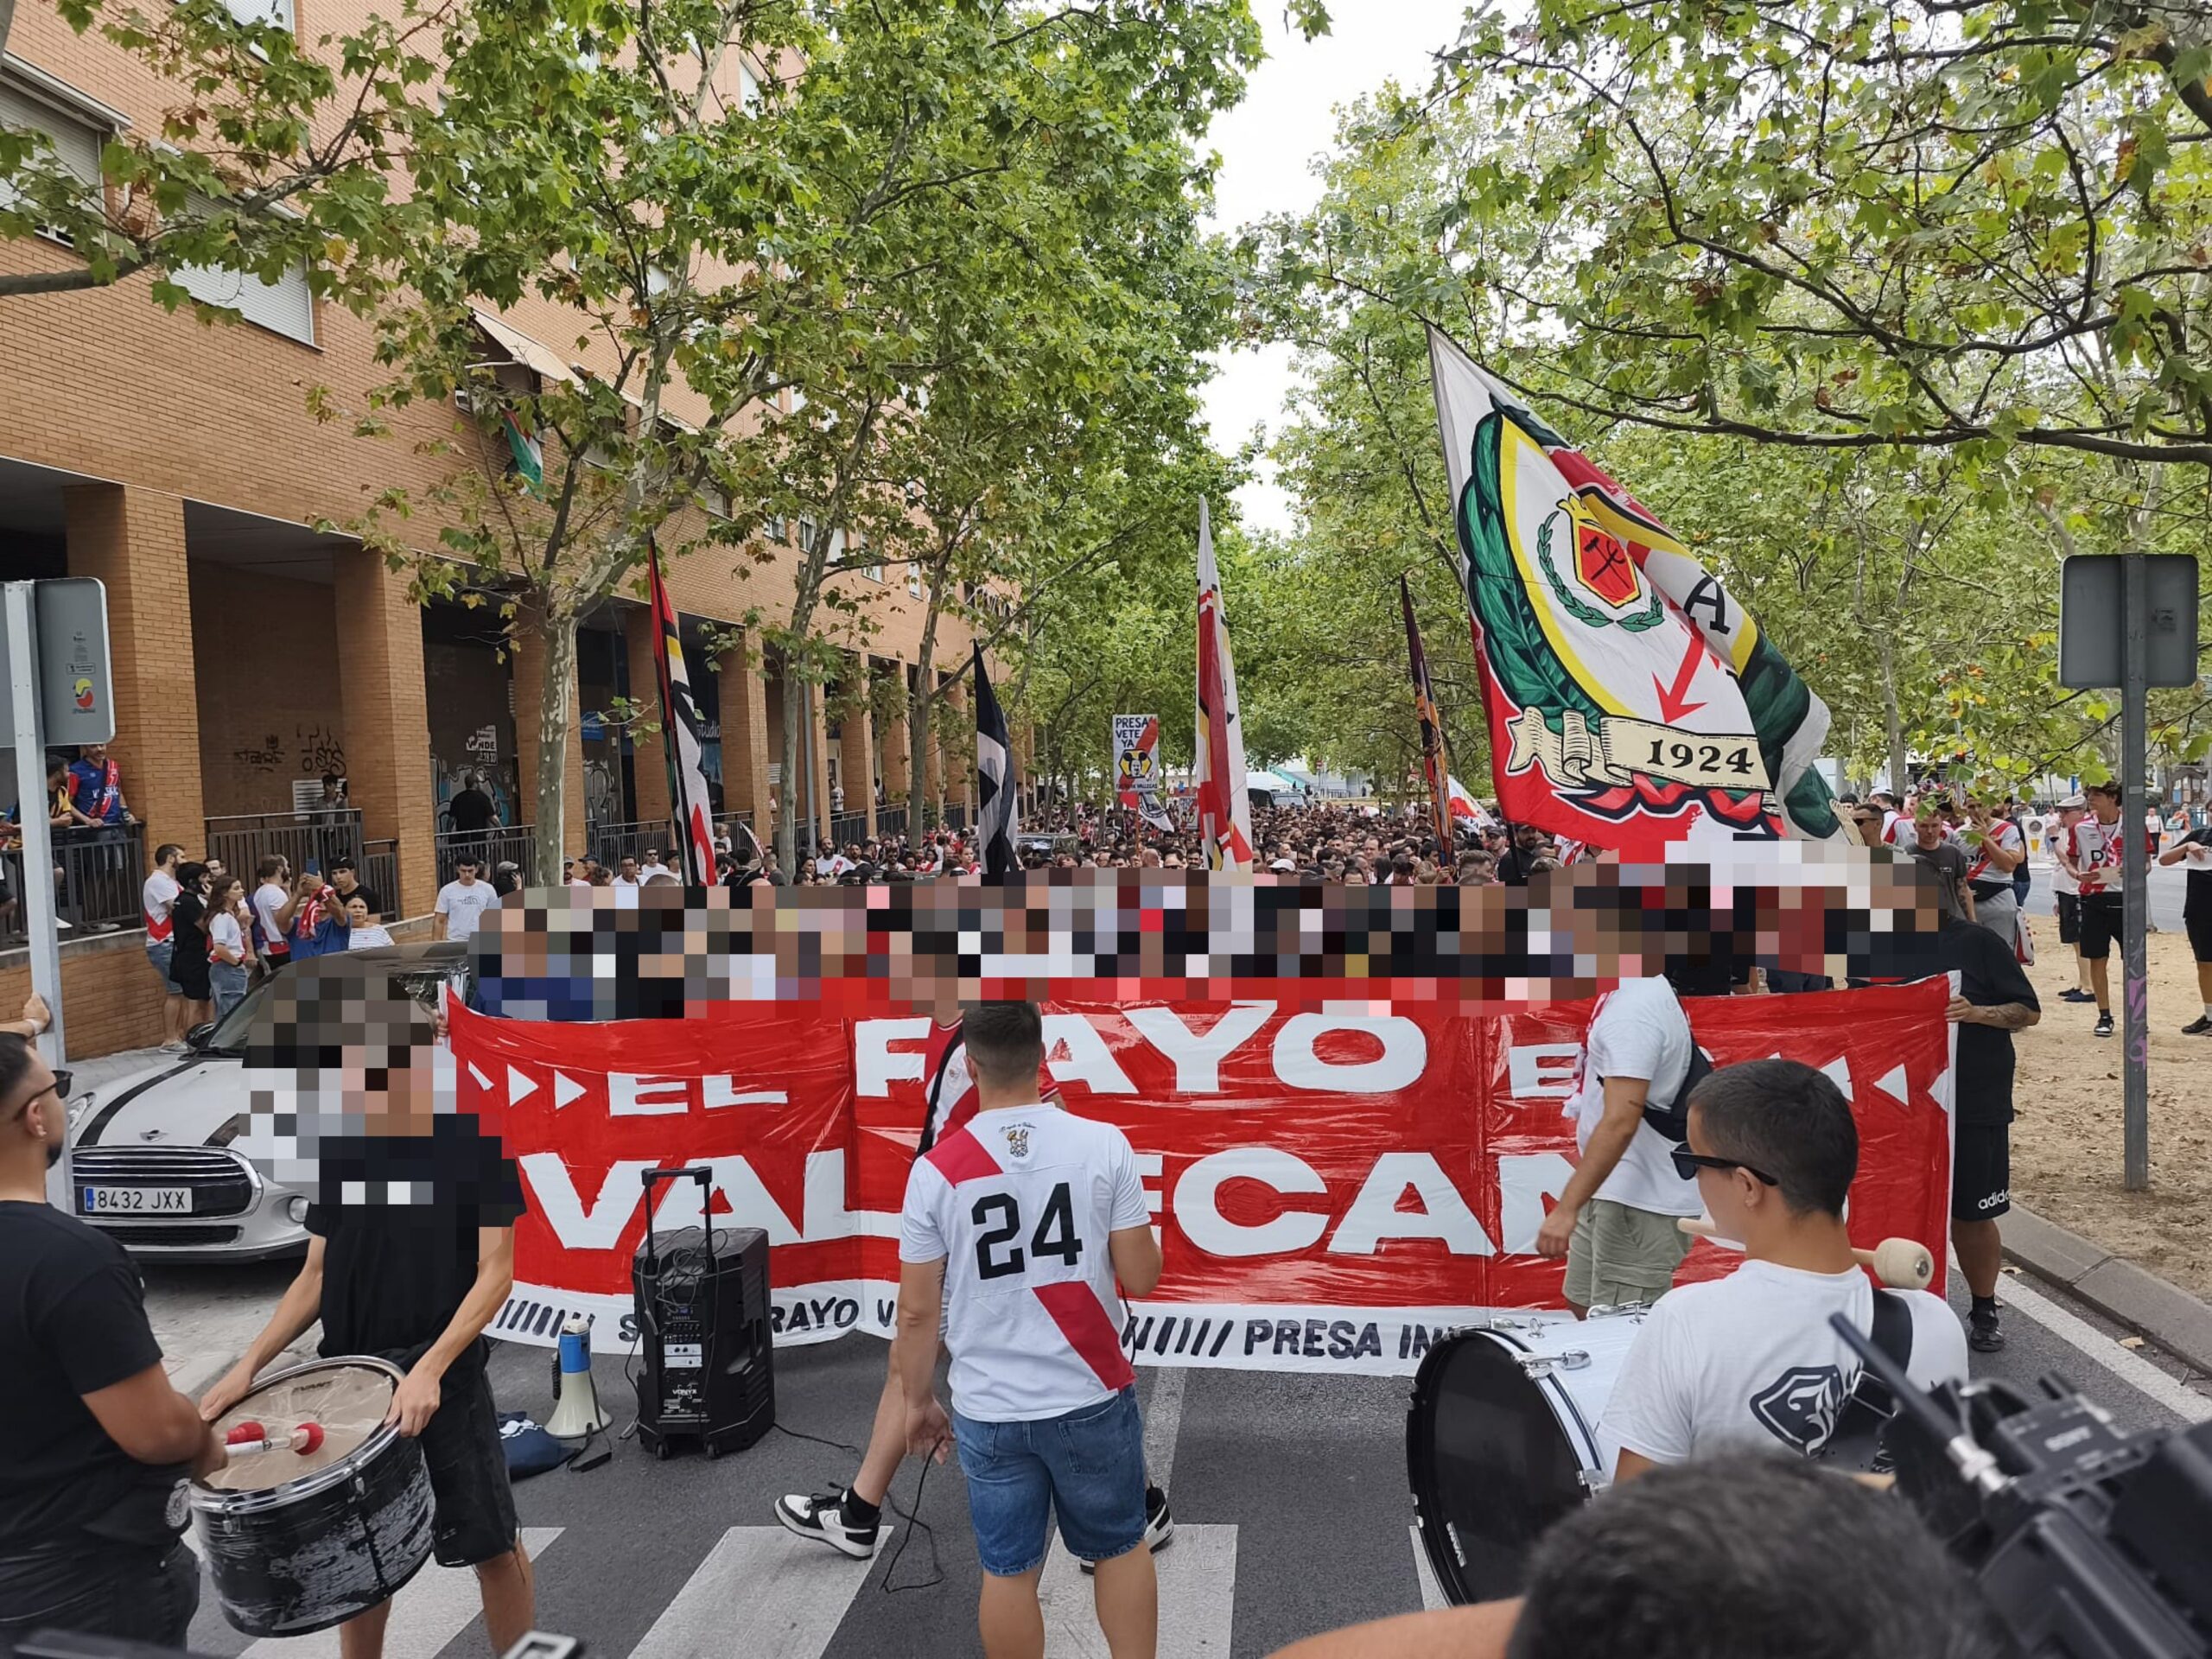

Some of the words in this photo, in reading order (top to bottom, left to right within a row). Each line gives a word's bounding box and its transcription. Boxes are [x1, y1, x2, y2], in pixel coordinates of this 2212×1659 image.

[1116, 717, 1149, 728] PRESA
[1116, 729, 1141, 739] VETE
[467, 741, 495, 750] VNDE
[1121, 739, 1135, 748] YA
[1646, 739, 1755, 775] 1924
[607, 1071, 788, 1117] EL
[98, 1191, 143, 1209] 8432
[151, 1191, 185, 1209] JXX
[518, 1147, 1849, 1258] VALCA
[971, 1182, 1083, 1280] 24
[771, 1296, 860, 1334] RAYO
[1243, 1319, 1382, 1359] PRESA
